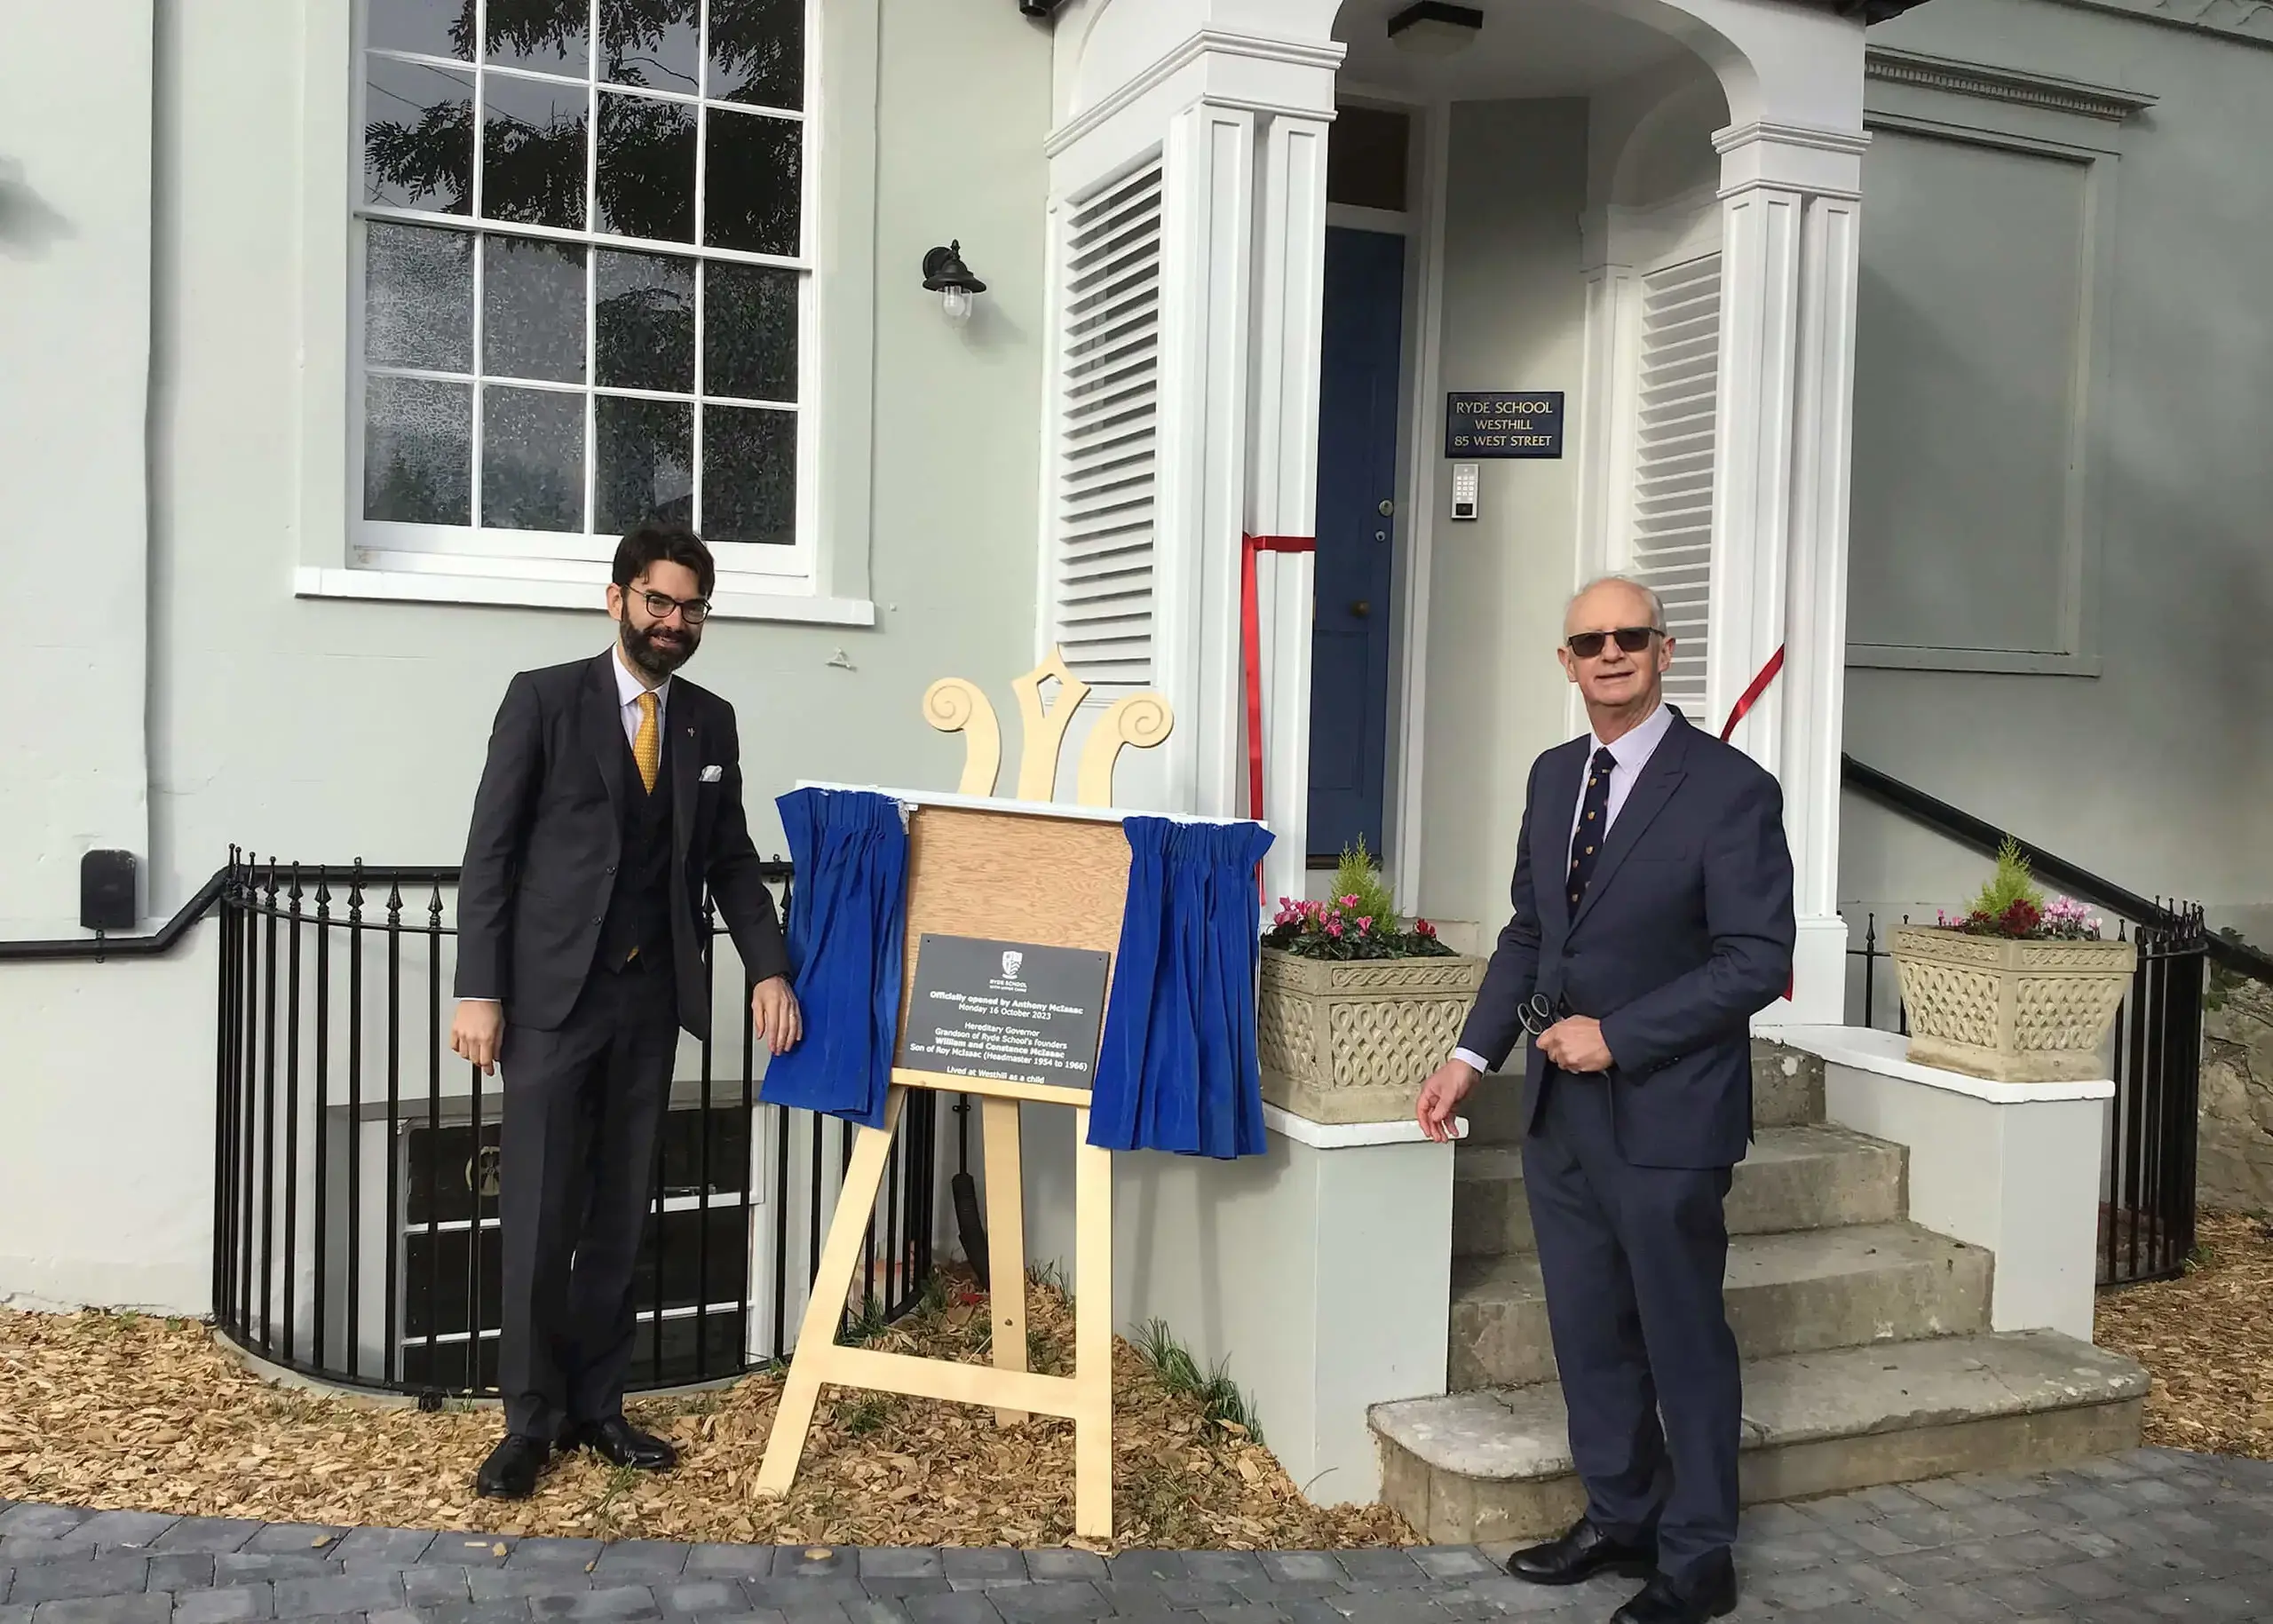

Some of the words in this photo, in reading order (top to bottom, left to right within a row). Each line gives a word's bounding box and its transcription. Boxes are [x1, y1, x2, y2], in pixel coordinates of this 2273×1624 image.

[1456, 401, 1491, 414] RYDE
[1495, 401, 1553, 414] SCHOOL
[1475, 419, 1533, 430] WESTHILL
[1454, 436, 1469, 447] 85
[1473, 435, 1507, 447] WEST
[1510, 435, 1552, 447] STREET
[930, 991, 967, 1002] Officially
[968, 996, 998, 1005] opened
[1000, 998, 1010, 1007] by
[1011, 1000, 1047, 1011] Anthony
[1049, 1003, 1084, 1015] McIsaac
[958, 1002, 987, 1015] Monday
[1001, 1008, 1030, 1018] October
[1032, 1010, 1051, 1020] 2023
[935, 1027, 970, 1038] Grandson
[981, 1033, 1001, 1042] Ryde
[1002, 1035, 1033, 1046] School's
[1034, 1039, 1067, 1050] founders
[964, 1022, 1003, 1033] Hereditary
[1005, 1026, 1041, 1037] Governor
[935, 1036, 967, 1047] William
[986, 1042, 1028, 1054] Constance
[1030, 1048, 1065, 1058] McIsaac
[910, 1042, 924, 1051] Son
[936, 1046, 950, 1057] Roy
[952, 1048, 982, 1058] McIsaac
[983, 1051, 1032, 1064] (Headmaster
[1034, 1058, 1053, 1066] 1954
[1065, 1060, 1088, 1072] 1966)
[946, 1066, 967, 1074] Lived
[968, 1067, 977, 1076] at
[978, 1069, 1008, 1080] Westhill
[1026, 1075, 1045, 1084] child
